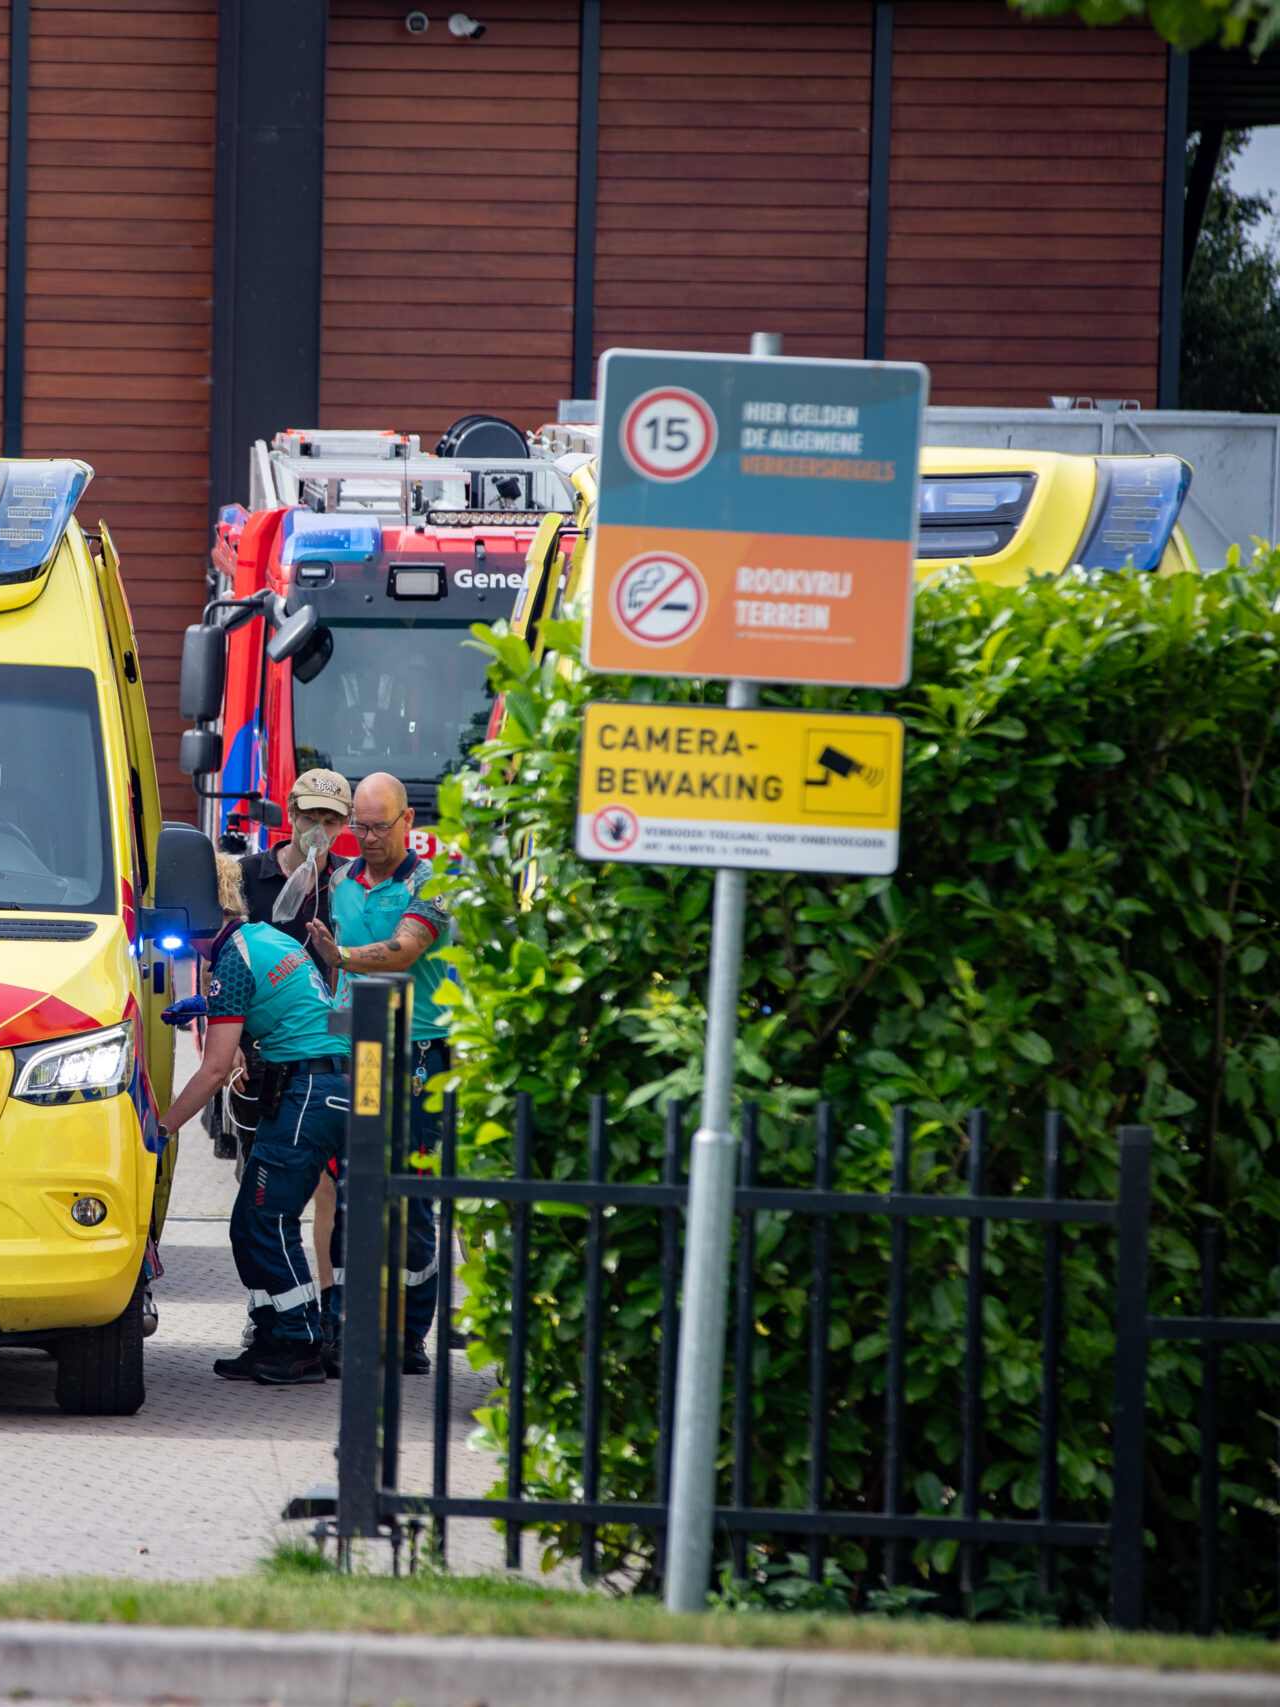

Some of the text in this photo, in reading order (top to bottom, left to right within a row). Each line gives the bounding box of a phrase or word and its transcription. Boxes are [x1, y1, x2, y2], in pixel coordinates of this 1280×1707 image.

[742, 401, 859, 427] HIER GELDEN
[645, 416, 690, 451] 15
[741, 428, 863, 455] DE ALGEMENE
[740, 455, 895, 482] VERKEERSREGELS
[736, 566, 853, 598] ROOKVRIJ
[734, 600, 830, 630] TERREIN
[599, 724, 759, 756] CAMERA-
[597, 767, 783, 801] BEWAKING
